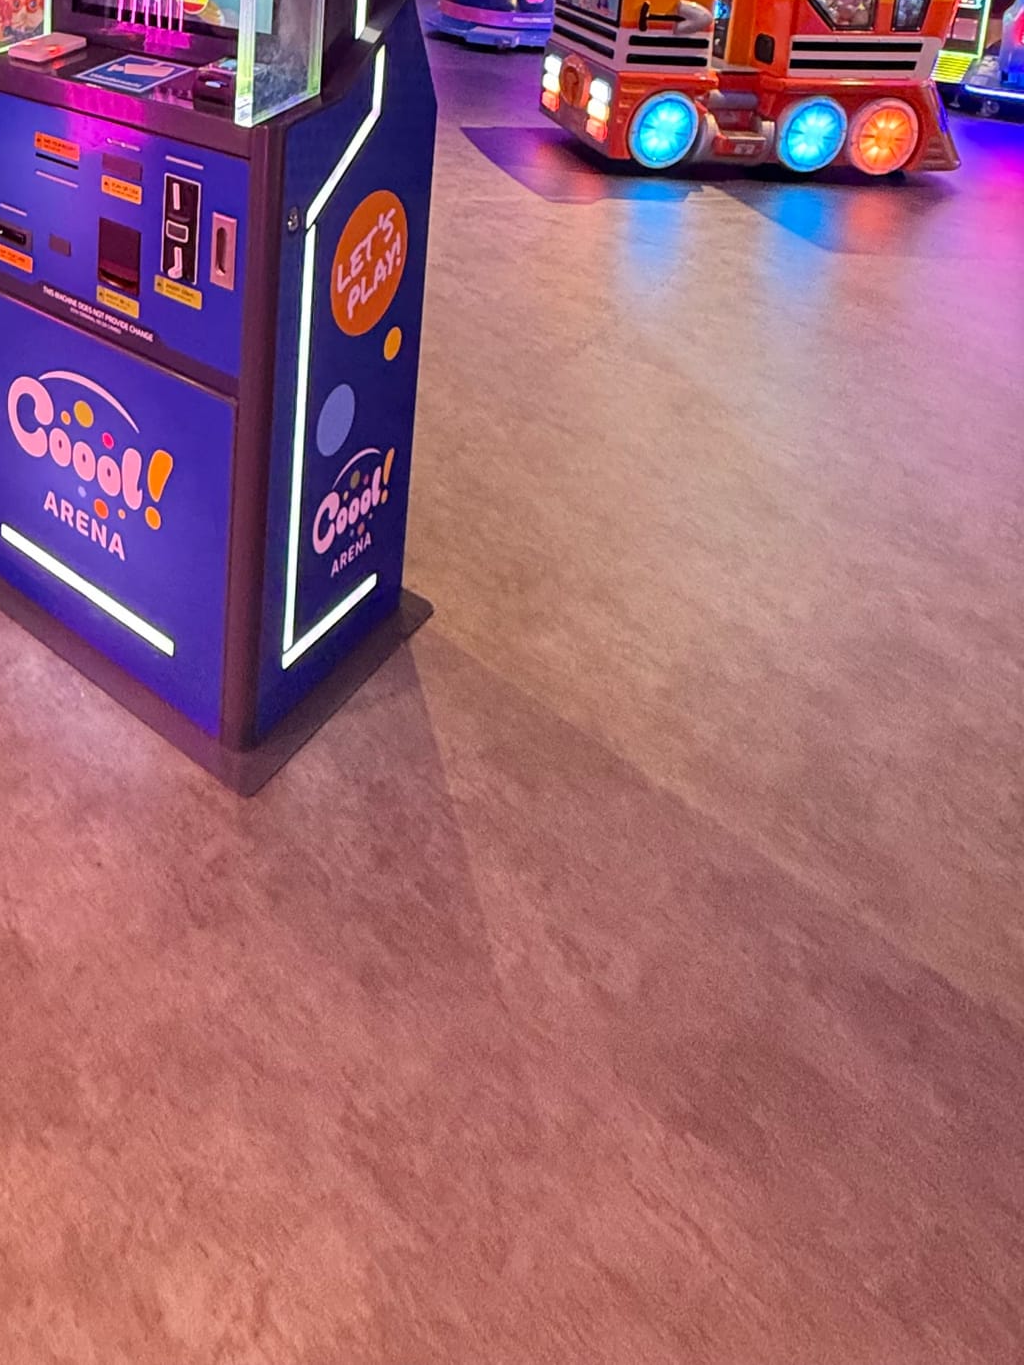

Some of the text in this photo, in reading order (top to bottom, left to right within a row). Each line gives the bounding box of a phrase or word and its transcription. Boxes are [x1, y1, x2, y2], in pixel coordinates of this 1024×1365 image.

[337, 208, 396, 293] LET'S
[347, 232, 401, 320] PLAY!
[8, 376, 174, 530] Coool!
[43, 490, 126, 561] ARENA
[313, 447, 395, 555] Coool!
[331, 532, 372, 578] ARENA
